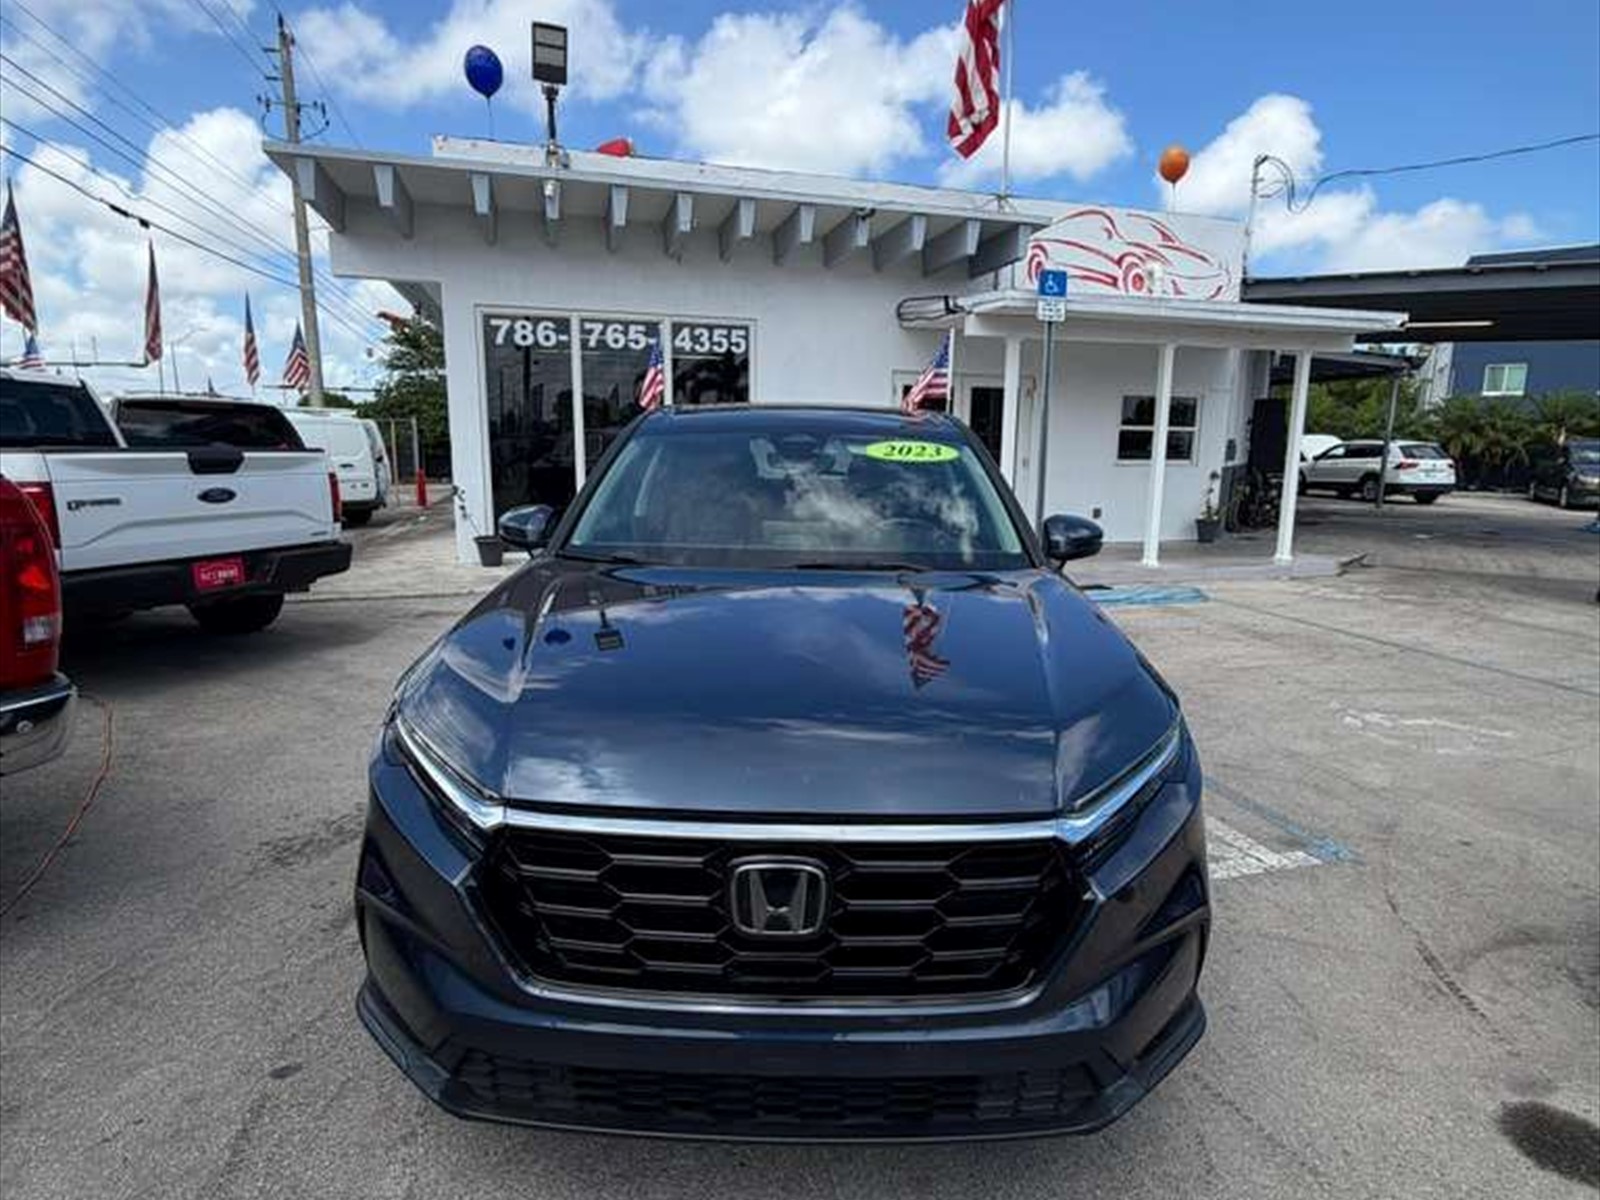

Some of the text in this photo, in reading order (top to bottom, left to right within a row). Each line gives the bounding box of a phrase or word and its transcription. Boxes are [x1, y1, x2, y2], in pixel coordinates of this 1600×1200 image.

[490, 318, 746, 354] 786- 765- 4355
[881, 444, 942, 458] 2023
